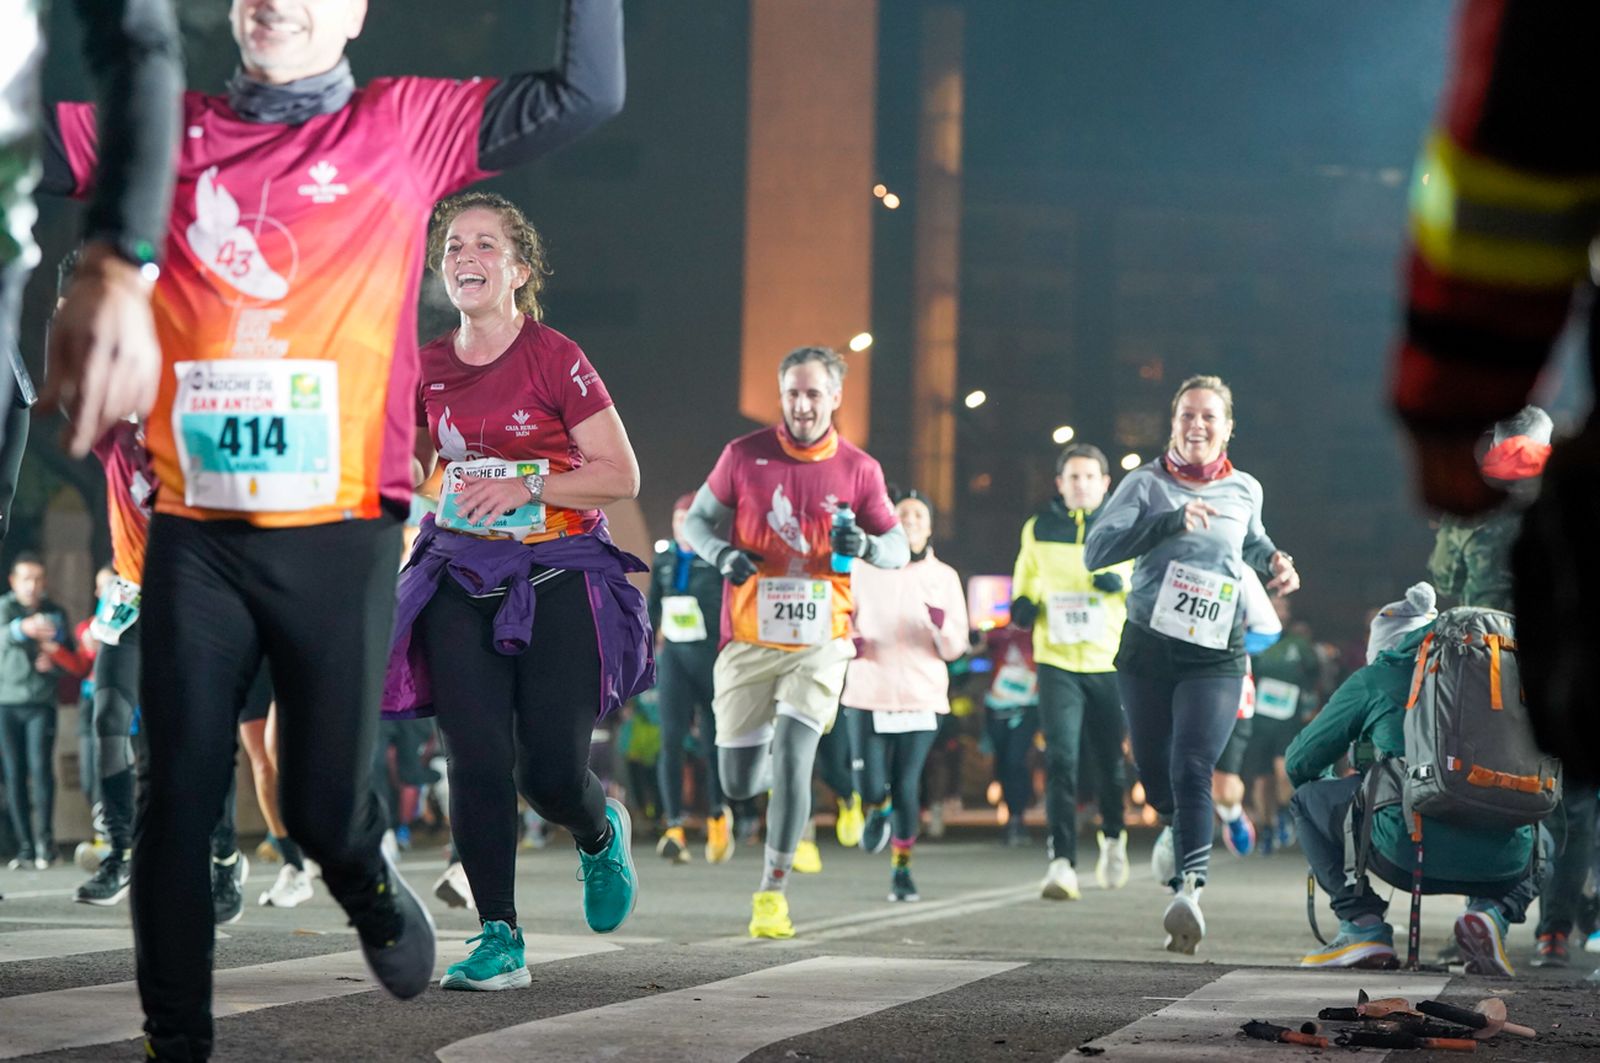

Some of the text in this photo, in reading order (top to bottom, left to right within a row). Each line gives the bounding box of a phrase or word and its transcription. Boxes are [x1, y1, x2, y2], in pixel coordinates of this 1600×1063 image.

[216, 241, 254, 278] 43
[191, 397, 217, 411] SAN
[218, 416, 287, 457] 414
[495, 468, 507, 477] DE
[774, 602, 816, 621] 2149
[1174, 592, 1220, 622] 2150
